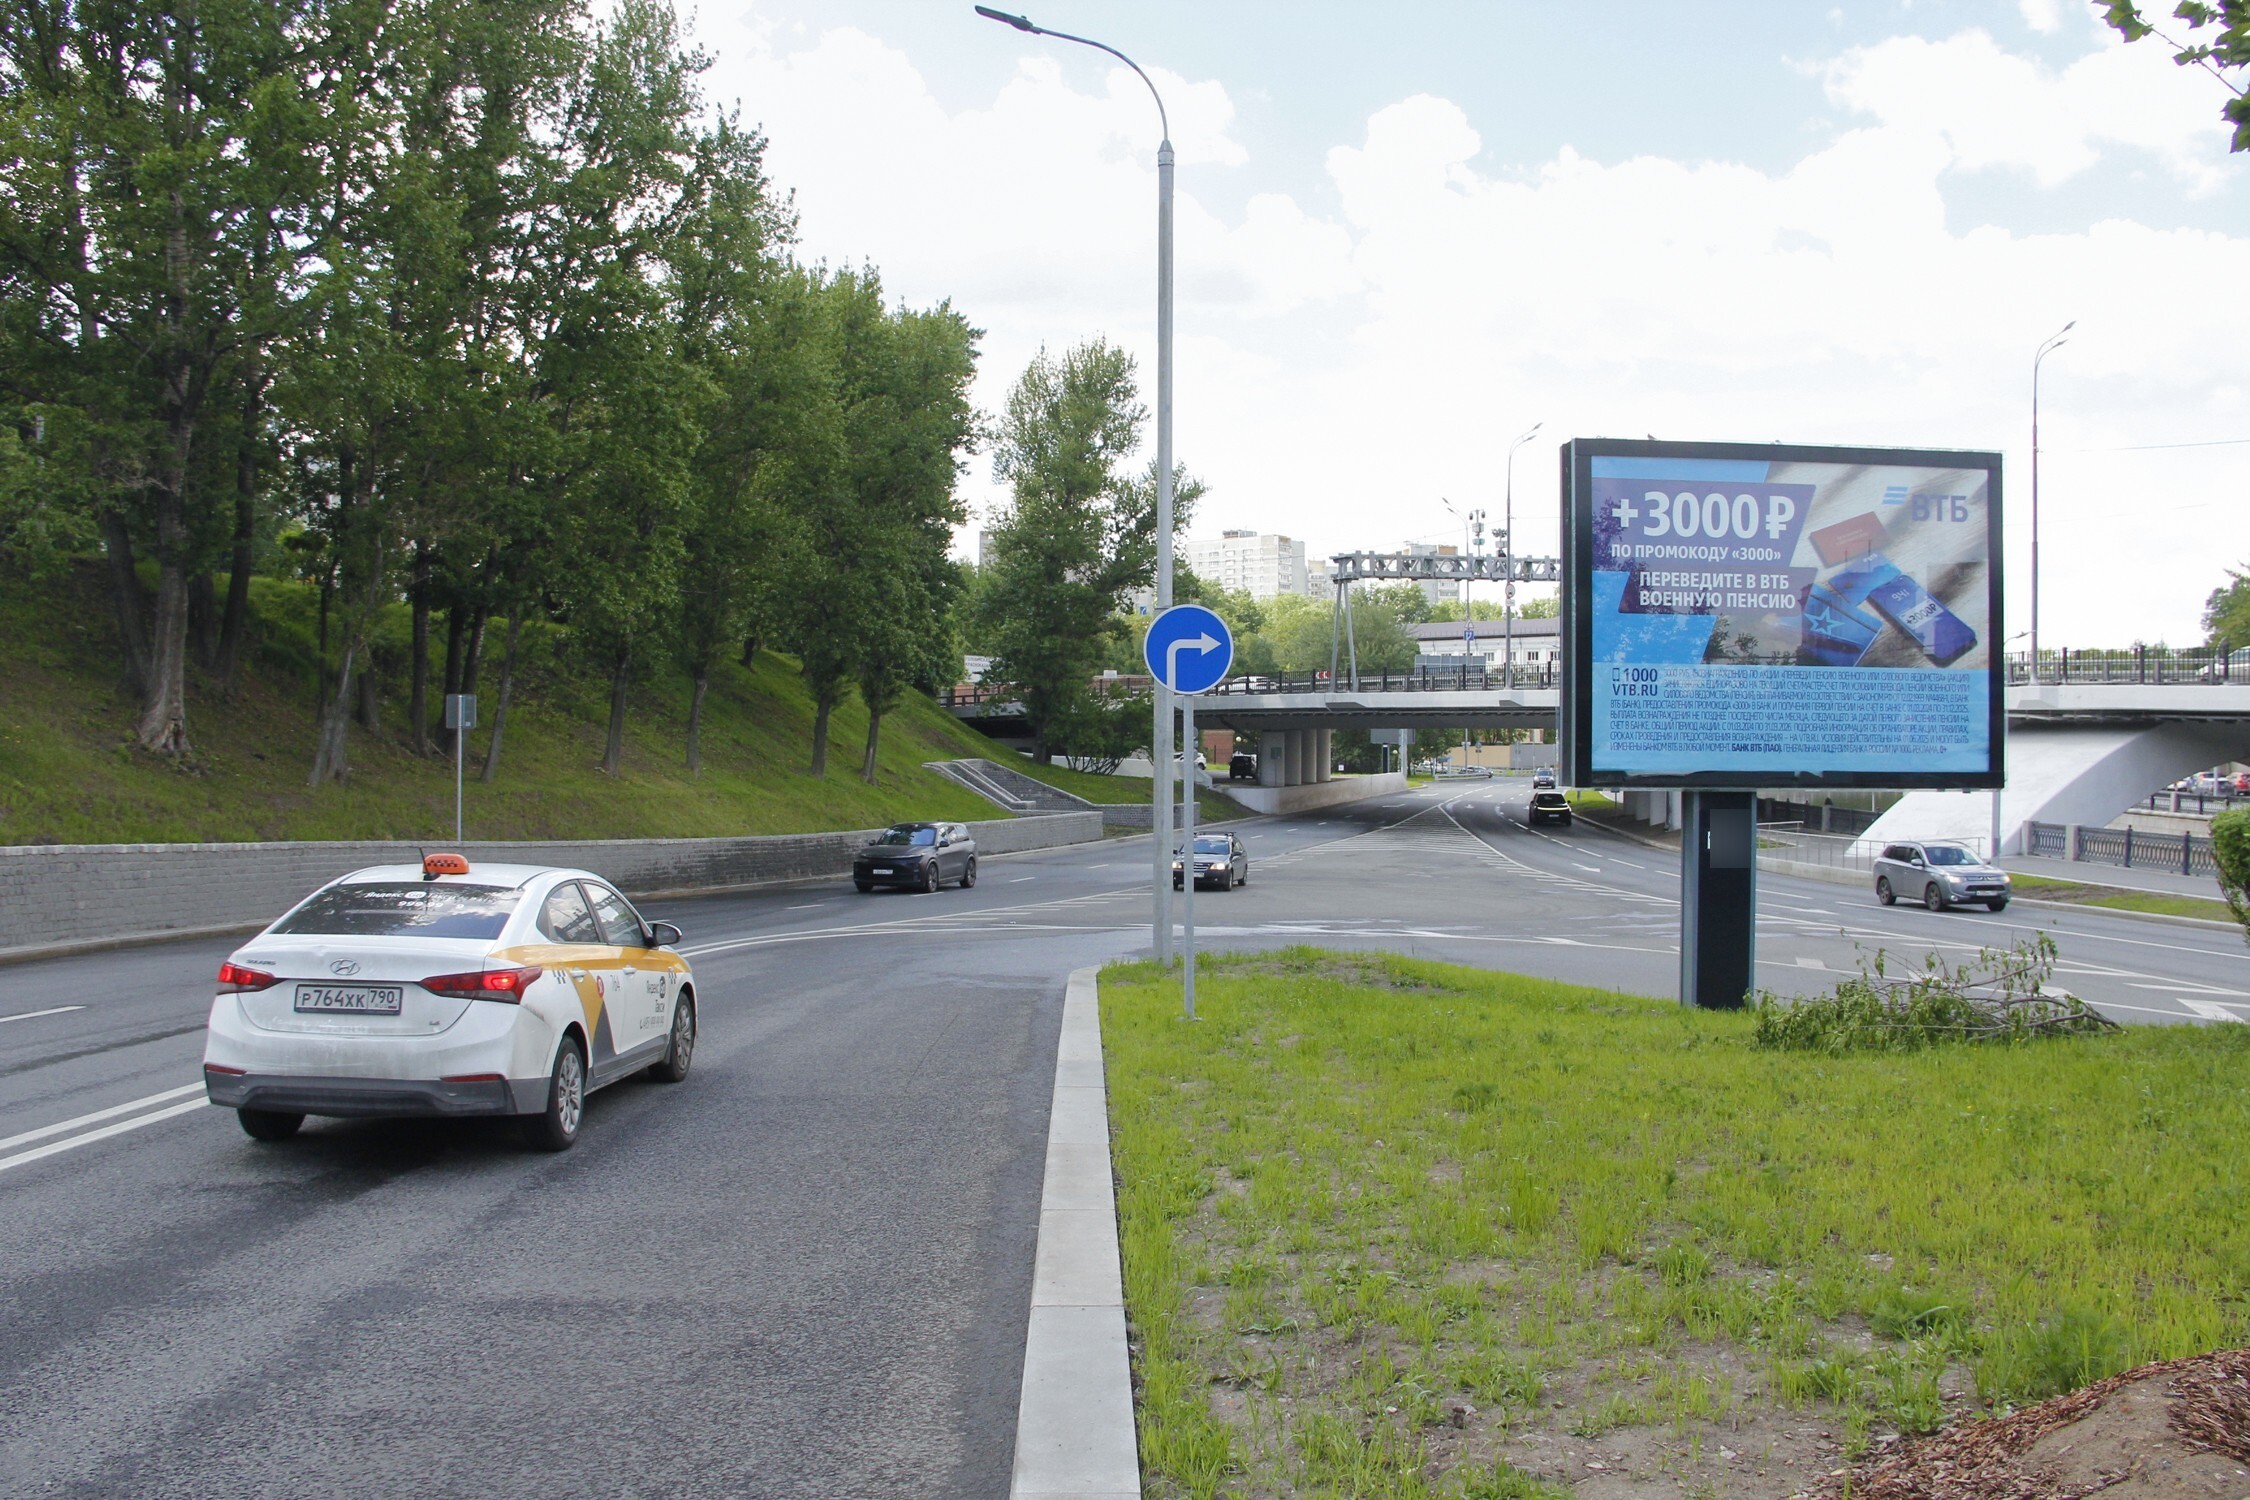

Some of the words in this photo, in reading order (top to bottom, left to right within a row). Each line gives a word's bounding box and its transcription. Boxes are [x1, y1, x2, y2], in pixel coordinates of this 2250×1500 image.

[1912, 494, 1968, 522] ВТБ
[1612, 544, 1631, 558] ПО
[1635, 544, 1728, 562] ПРОМОКОДУ
[1732, 548, 1781, 561] «3000»
[1639, 572, 1742, 590] ПЕРЕВЕДИТЕ
[1747, 575, 1756, 588] В
[1760, 575, 1789, 589] ВТБ
[1639, 590, 1722, 607] ВОЕННУЮ
[1727, 593, 1795, 608] ПЕНСИЮ
[1623, 668, 1658, 682] 1000
[1613, 684, 1658, 696] VTB.RU
[1731, 743, 1749, 752] БАНК
[1750, 743, 1763, 752] ВТБ
[302, 989, 366, 1008] Р764ХК
[370, 990, 395, 1003] 790
